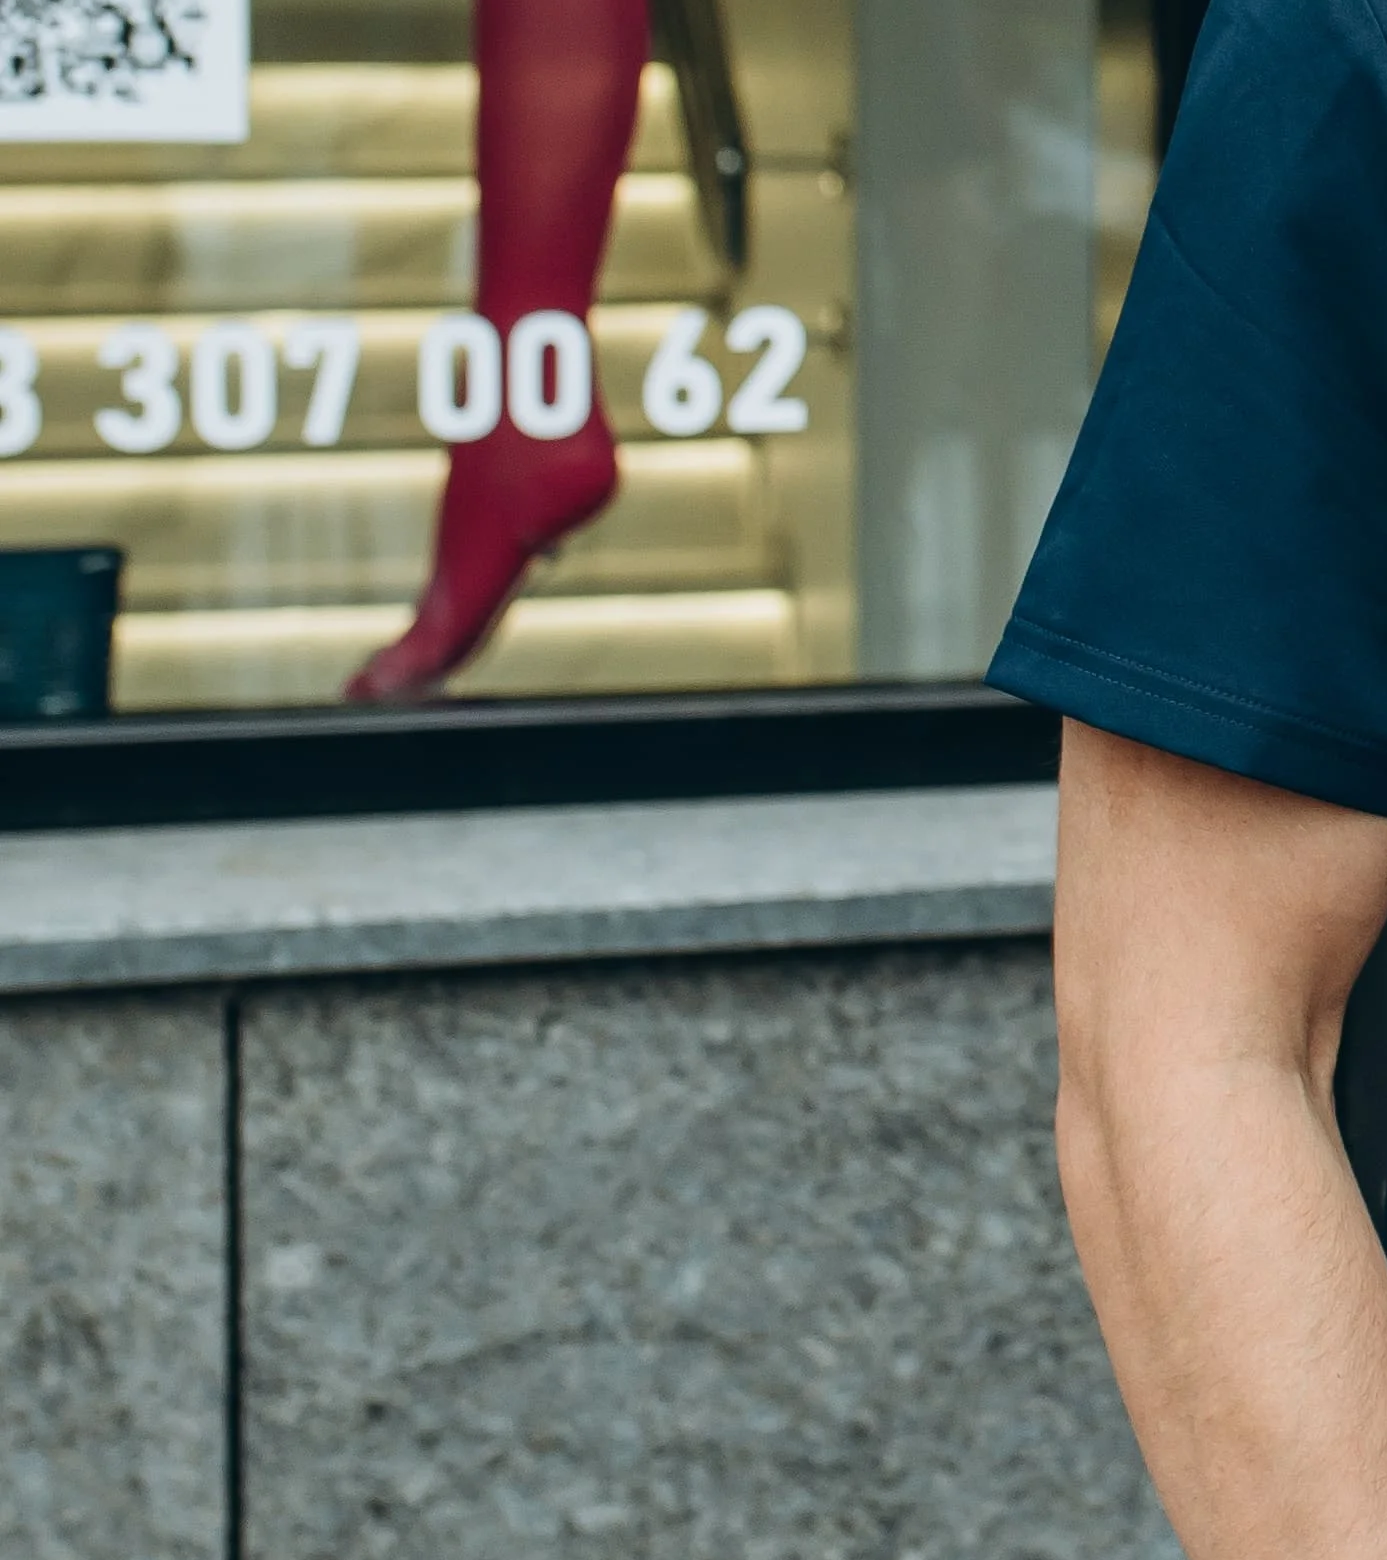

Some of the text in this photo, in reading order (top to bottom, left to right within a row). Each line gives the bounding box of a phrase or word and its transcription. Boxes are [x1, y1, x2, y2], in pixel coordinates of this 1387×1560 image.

[93, 319, 361, 454] 307
[417, 309, 594, 442] 00
[641, 304, 809, 437] 62
